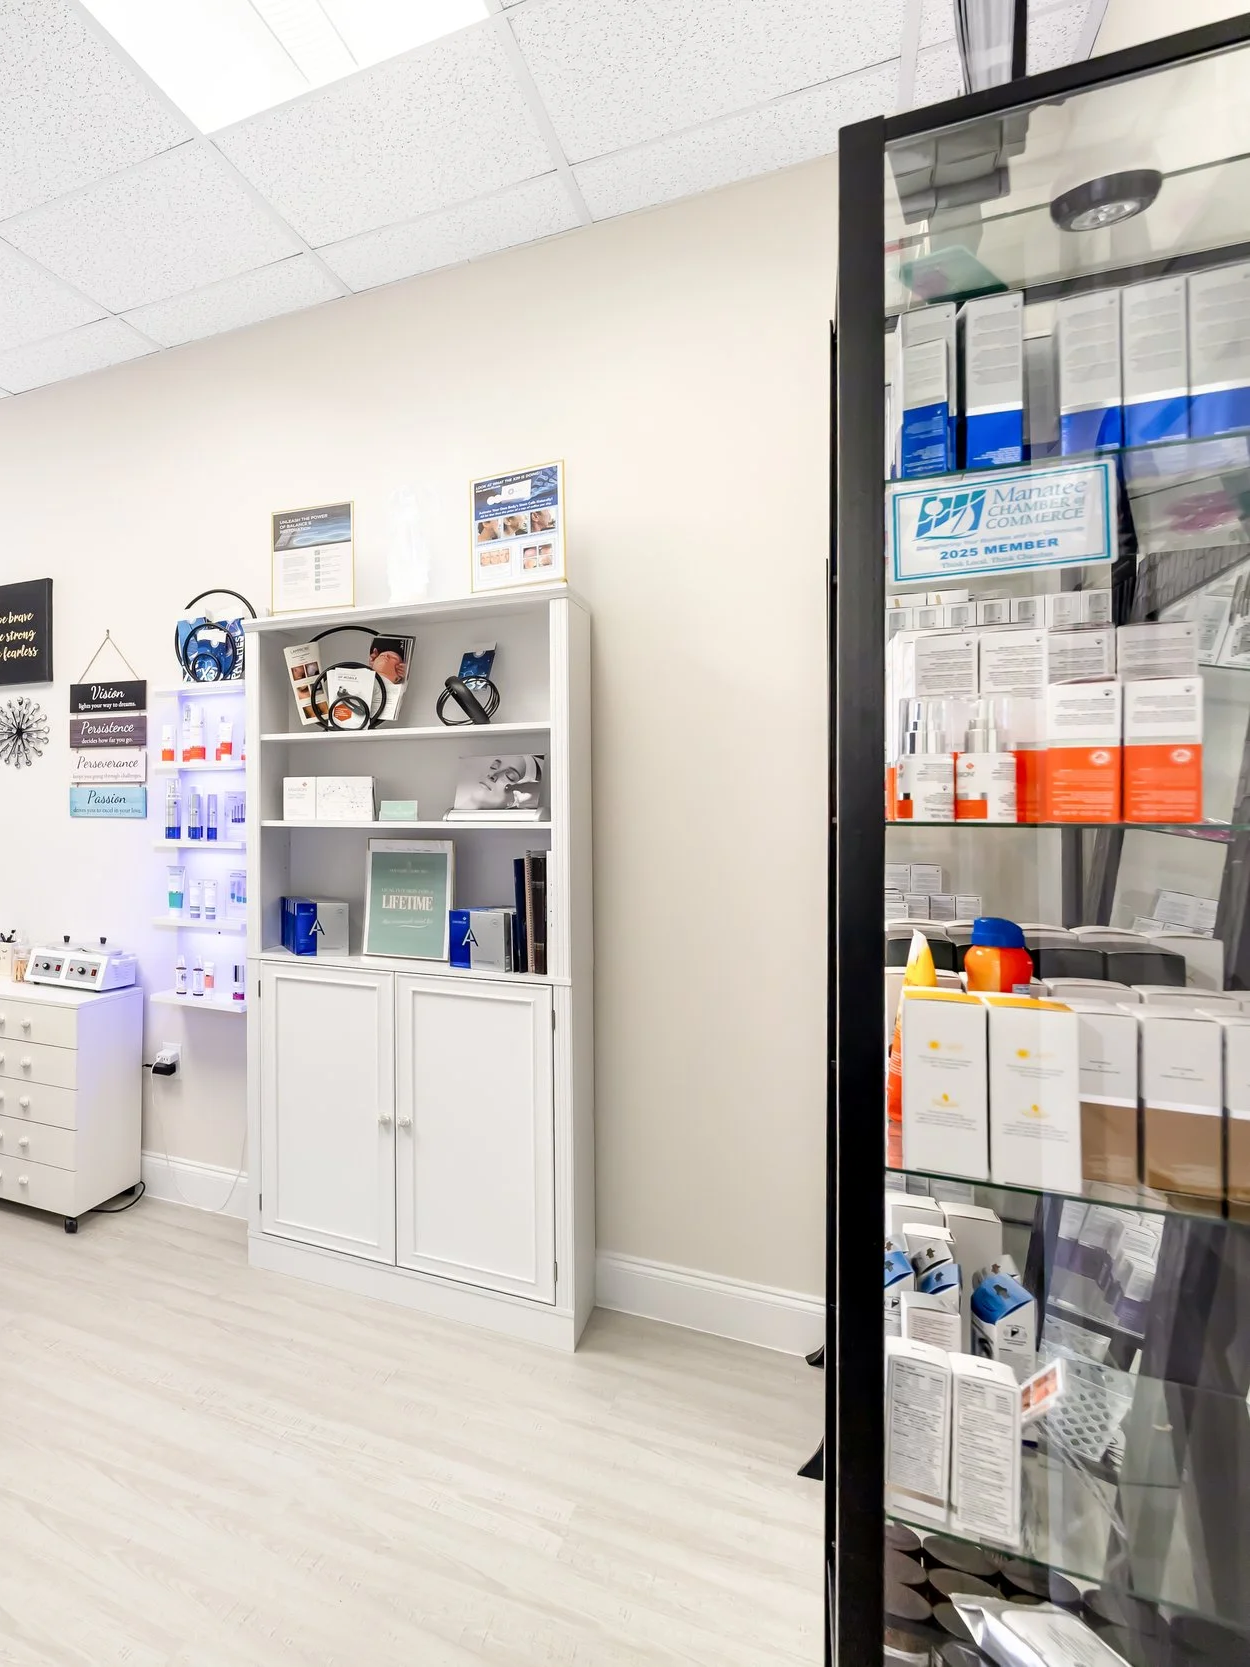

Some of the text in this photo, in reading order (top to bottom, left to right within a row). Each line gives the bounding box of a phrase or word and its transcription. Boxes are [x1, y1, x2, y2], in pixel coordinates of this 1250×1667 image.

[993, 481, 1087, 505] Manatee
[988, 497, 1070, 517] CHAMBER
[986, 508, 1085, 529] COMMERCE
[940, 538, 1059, 560] 2025 MEMBER
[8, 611, 34, 624] brave
[6, 630, 36, 642] strong
[3, 644, 38, 661] fearless
[91, 686, 125, 700] Vision
[81, 721, 134, 735] Persistence
[77, 756, 138, 769] Perseverance
[88, 790, 126, 804] Passion
[382, 894, 434, 911] LIFETIME
[308, 920, 325, 936] A
[462, 928, 478, 947] A
